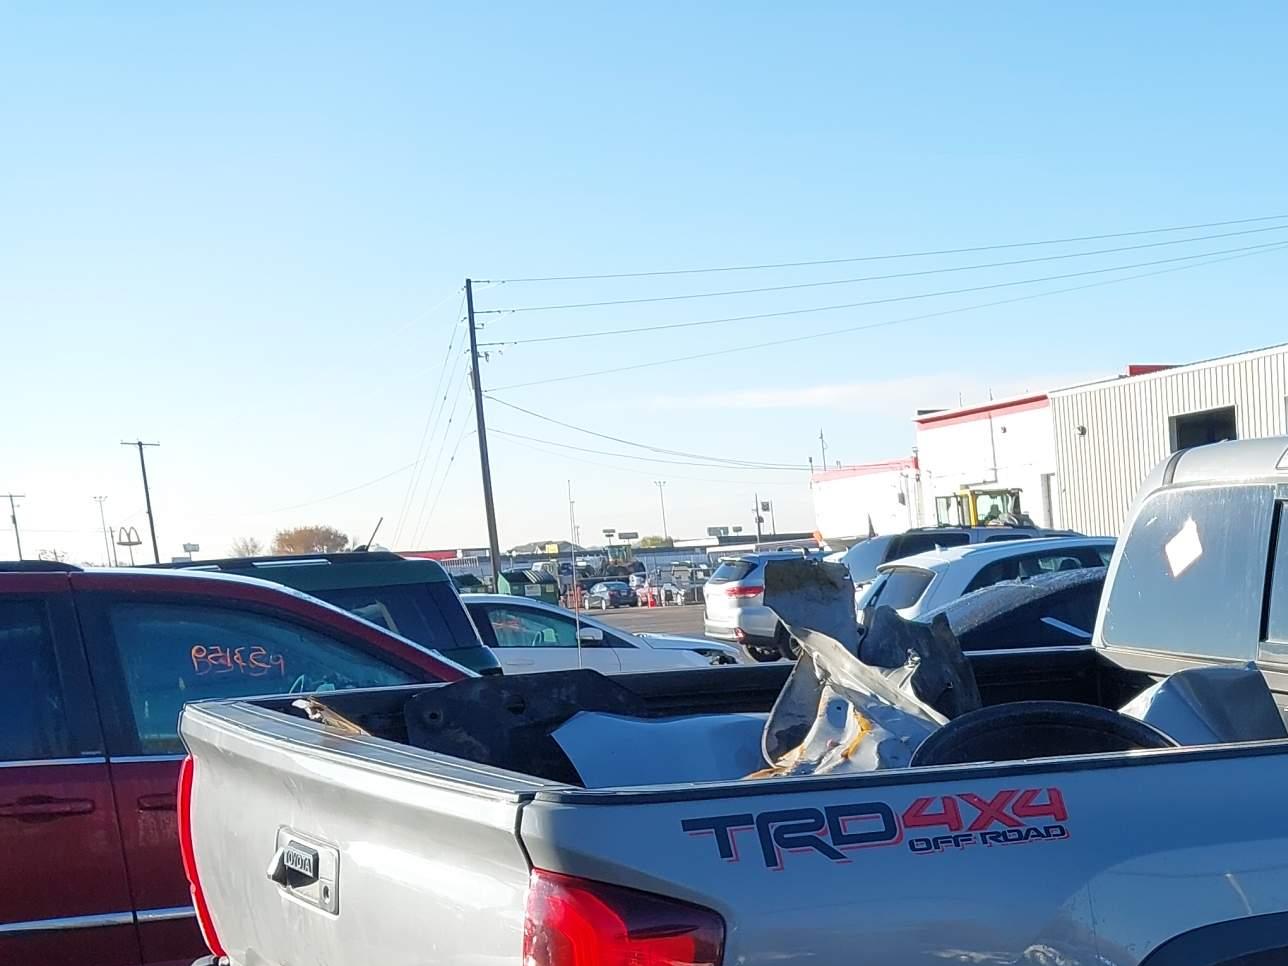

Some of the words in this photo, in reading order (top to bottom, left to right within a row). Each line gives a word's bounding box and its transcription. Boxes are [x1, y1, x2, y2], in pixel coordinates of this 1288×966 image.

[681, 802, 903, 871] TRD
[909, 832, 978, 854] OFF
[980, 824, 1070, 847] ROAD
